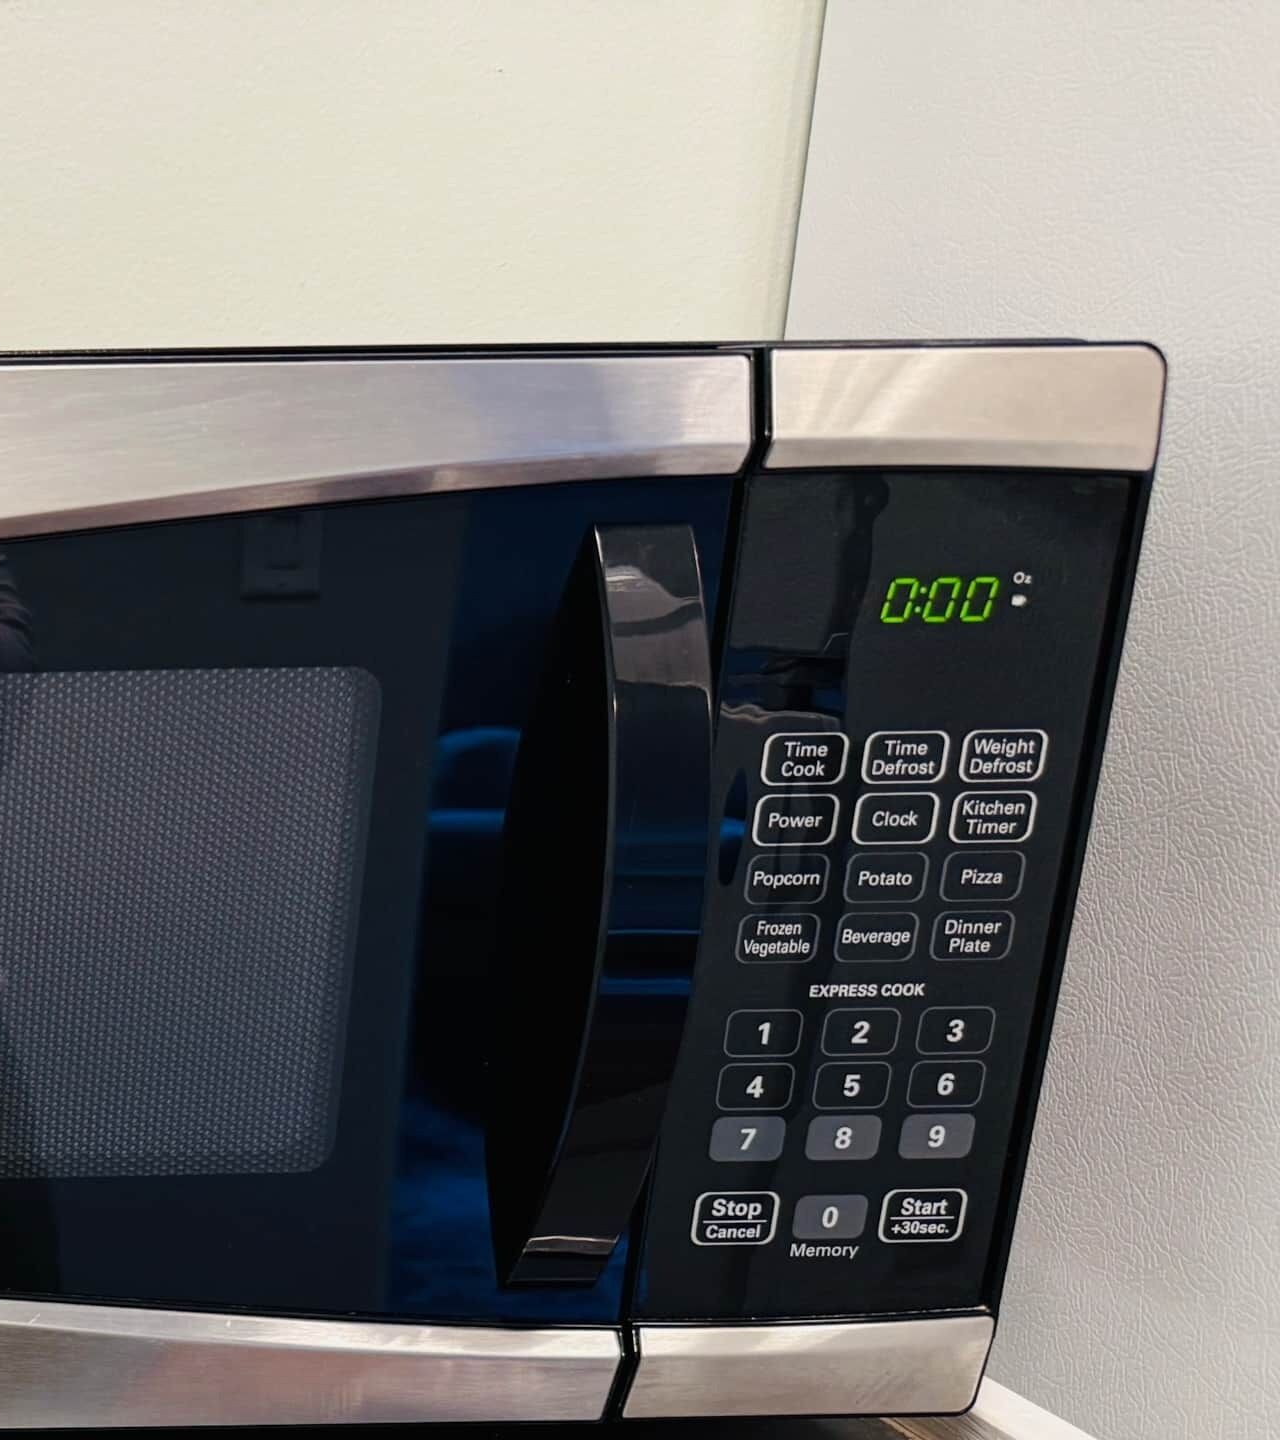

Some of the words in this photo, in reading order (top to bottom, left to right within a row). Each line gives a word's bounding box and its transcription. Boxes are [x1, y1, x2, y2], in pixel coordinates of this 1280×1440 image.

[1013, 571, 1032, 585] Oz
[880, 576, 999, 624] 0:00
[784, 741, 829, 757] Time
[884, 739, 929, 756] Time
[972, 738, 1037, 757] Weight
[781, 760, 825, 777] Cook
[871, 759, 935, 776] Defrost
[969, 757, 1034, 775] Defrost
[962, 799, 1026, 816] Kitchen
[768, 812, 823, 828] Power
[872, 810, 918, 827] Clock
[966, 818, 1017, 835] Timer
[752, 870, 821, 889] Popcorn
[857, 870, 913, 886] Potato
[960, 868, 1003, 885] Pizza
[756, 920, 802, 936] Frozen
[944, 919, 1002, 935] Dinner
[841, 928, 911, 947] Beverage
[948, 937, 991, 953] Plate
[743, 938, 810, 958] Vegetable
[809, 983, 878, 998] EXPRESS
[880, 983, 926, 997] COOK
[758, 1022, 771, 1045] 1
[851, 1020, 870, 1044] 2
[946, 1019, 965, 1043] 3
[746, 1075, 764, 1099] 4
[843, 1074, 861, 1097] 5
[937, 1072, 955, 1096] 6
[740, 1127, 758, 1151] 7
[834, 1126, 853, 1150] 8
[927, 1124, 947, 1149] 9
[711, 1198, 765, 1222] Stop
[900, 1197, 950, 1218] Start
[821, 1205, 840, 1229] 0
[890, 1217, 953, 1234] +30sec.
[705, 1223, 761, 1239] Cancel
[789, 1243, 860, 1259] Memory
